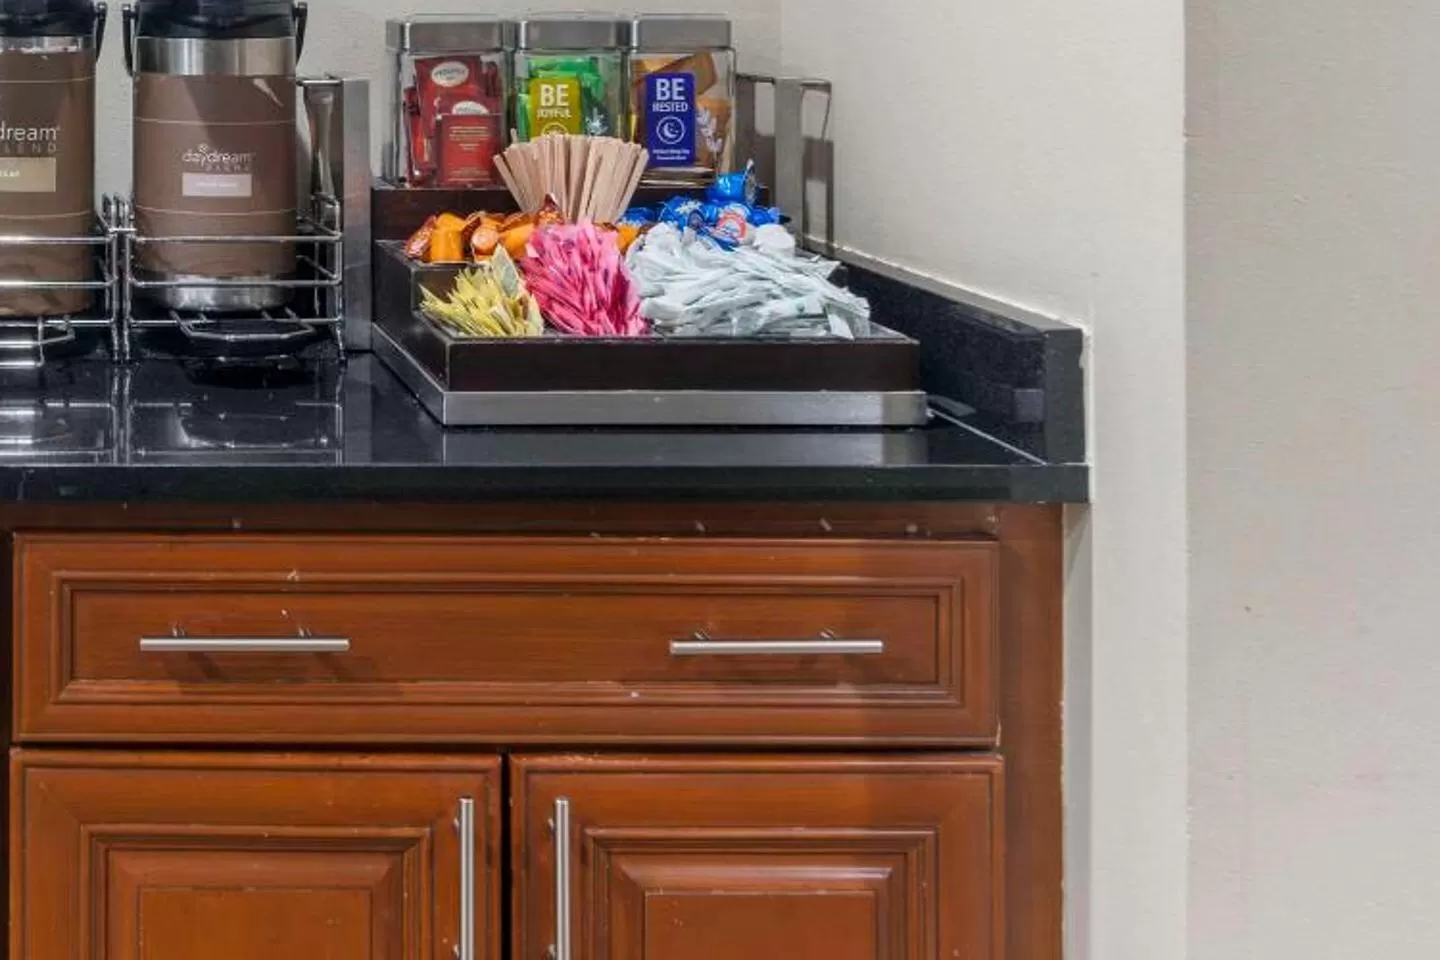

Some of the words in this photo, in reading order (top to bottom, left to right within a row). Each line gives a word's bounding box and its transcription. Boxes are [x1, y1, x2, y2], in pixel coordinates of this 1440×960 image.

[540, 84, 570, 106] BE
[655, 78, 686, 101] BE
[536, 108, 572, 119] JOYFUL
[652, 102, 689, 113] RESTED
